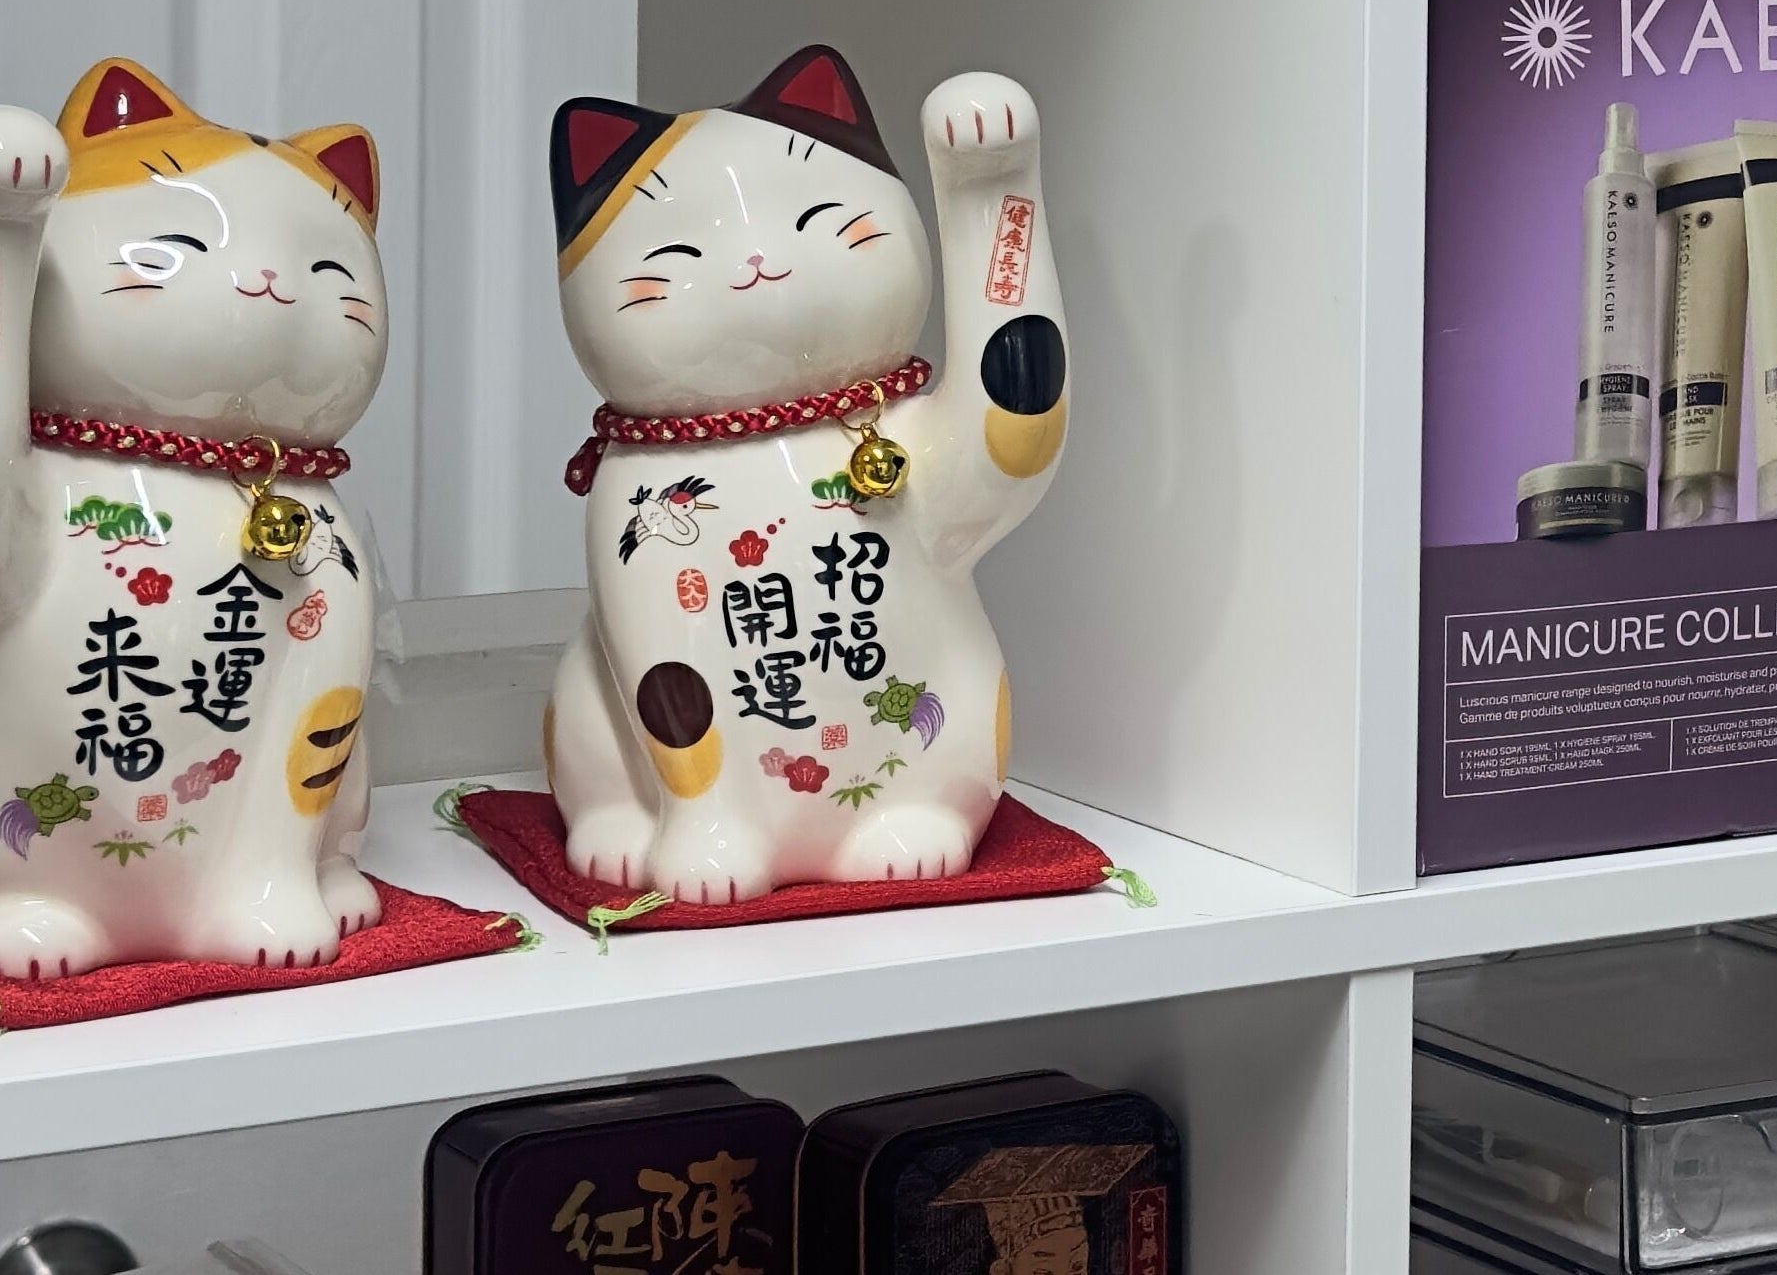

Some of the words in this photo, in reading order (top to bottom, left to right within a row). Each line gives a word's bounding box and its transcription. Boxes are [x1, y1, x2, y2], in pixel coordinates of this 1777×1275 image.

[180, 562, 283, 732] 金運
[720, 572, 817, 731] 開運
[810, 531, 891, 682] 招福
[1461, 614, 1665, 667] MANICURE
[66, 607, 177, 782] 来福
[1504, 708, 1517, 720] de
[1662, 692, 1685, 705] pour
[1511, 688, 1559, 703] manicure
[1561, 686, 1590, 700] range
[1593, 679, 1640, 697] designed
[1642, 679, 1652, 690] to
[1749, 666, 1768, 678] and
